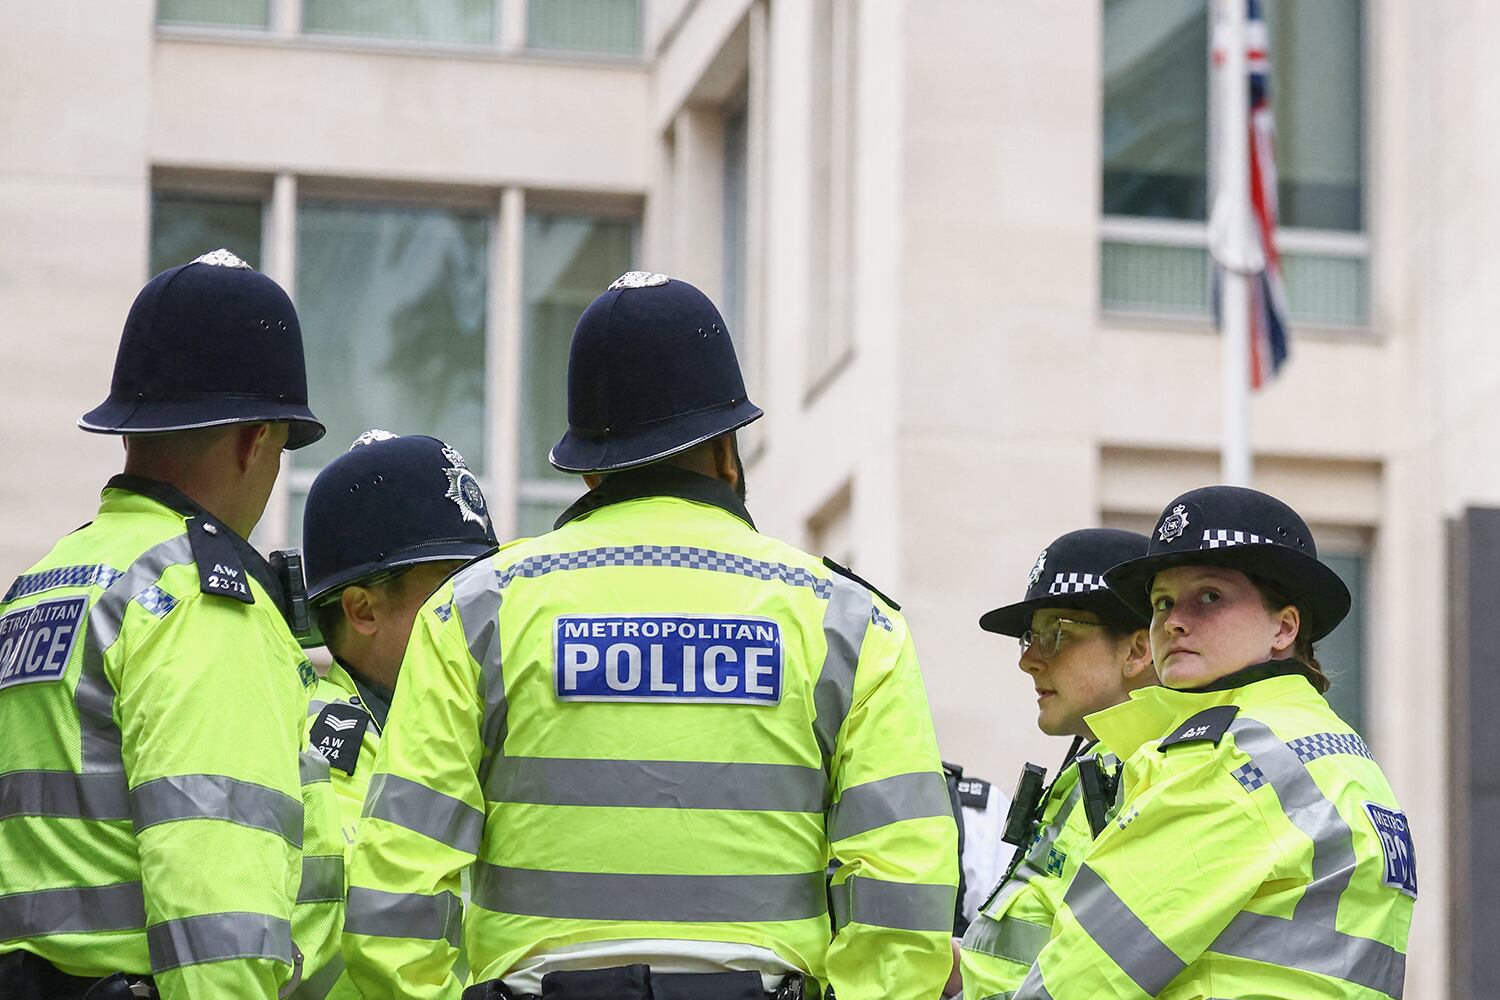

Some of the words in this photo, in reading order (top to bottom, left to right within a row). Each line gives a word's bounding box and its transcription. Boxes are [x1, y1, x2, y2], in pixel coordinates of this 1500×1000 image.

[213, 564, 238, 578] AW
[208, 576, 247, 595] 2371
[0, 603, 80, 636] ETROOLITAN
[564, 622, 774, 642] METROPOLITAN
[0, 626, 72, 678] OLICE
[564, 642, 774, 695] POLICE
[320, 736, 345, 748] AW
